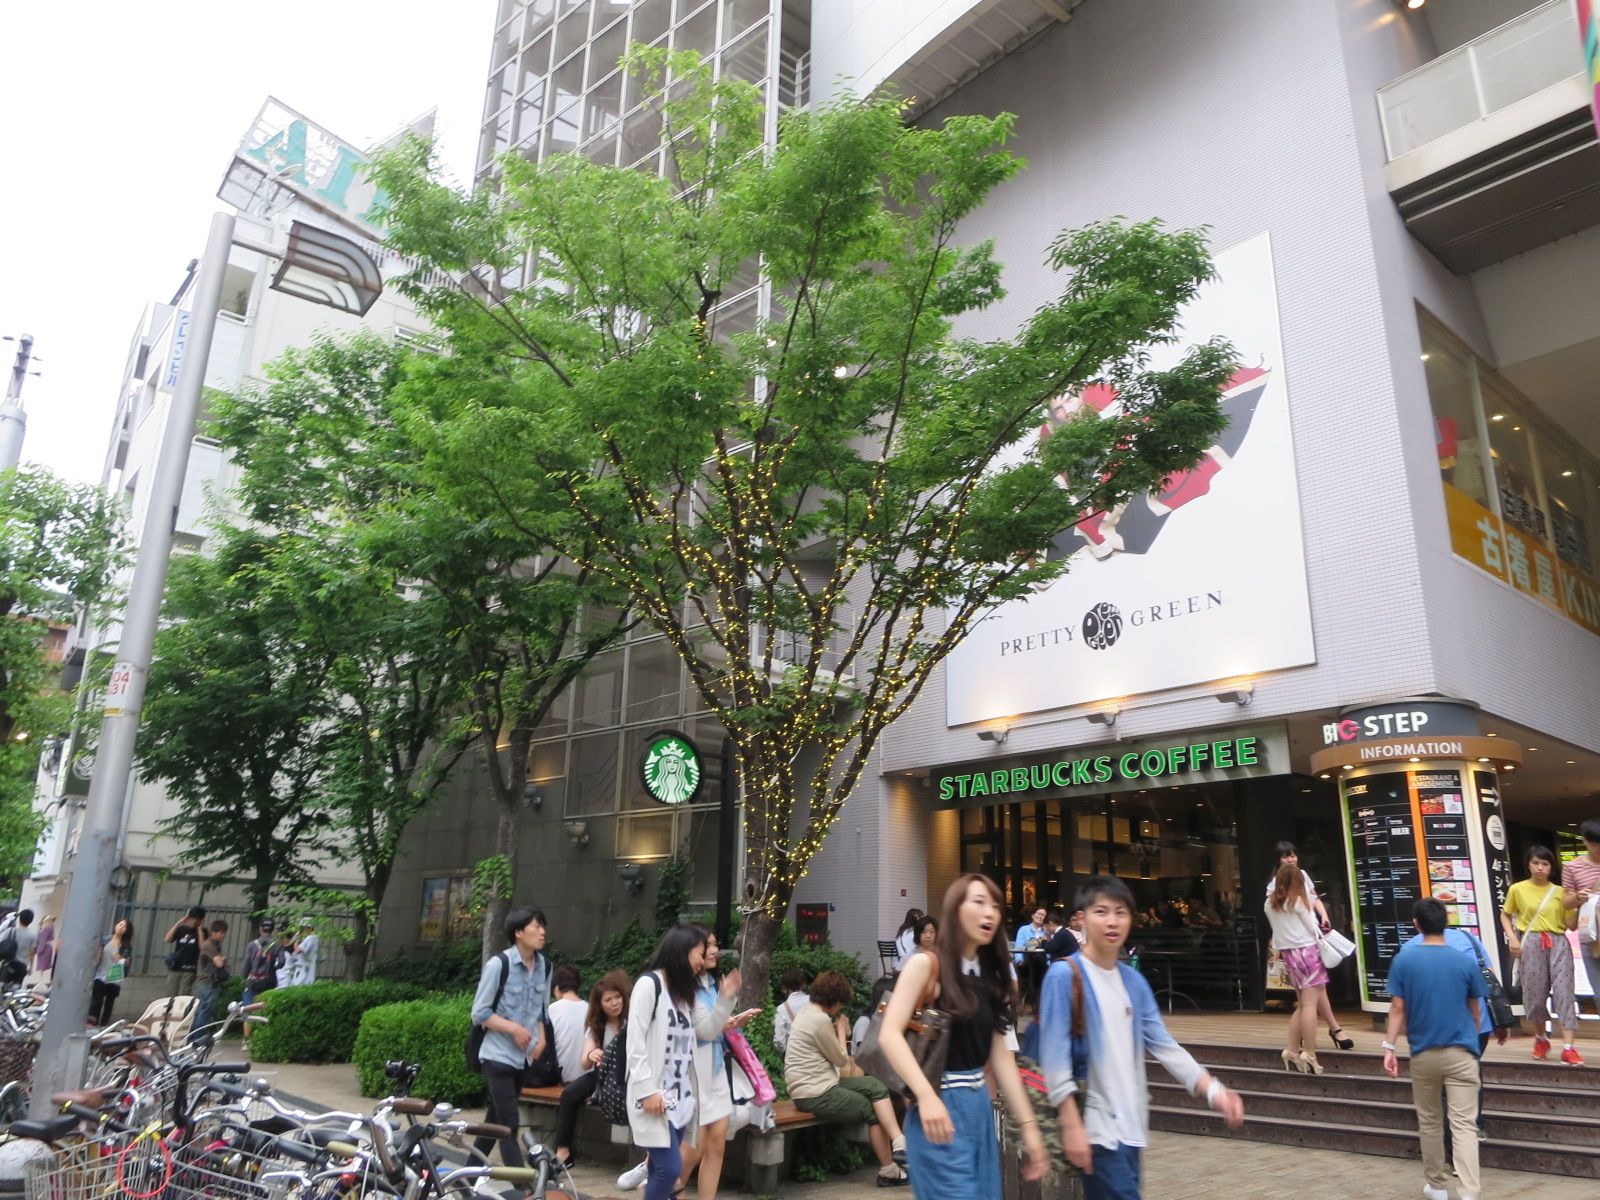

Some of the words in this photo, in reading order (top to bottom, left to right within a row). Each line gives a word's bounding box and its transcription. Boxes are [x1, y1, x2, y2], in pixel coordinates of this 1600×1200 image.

[1000, 624, 1077, 656] PRETTY
[1130, 590, 1223, 627] GREEN
[1323, 719, 1360, 745] BIG
[1364, 711, 1429, 736] STEP
[1360, 742, 1463, 759] INFORMATION
[939, 756, 1112, 800] STARBUCKS
[1119, 736, 1258, 779] COFFEE
